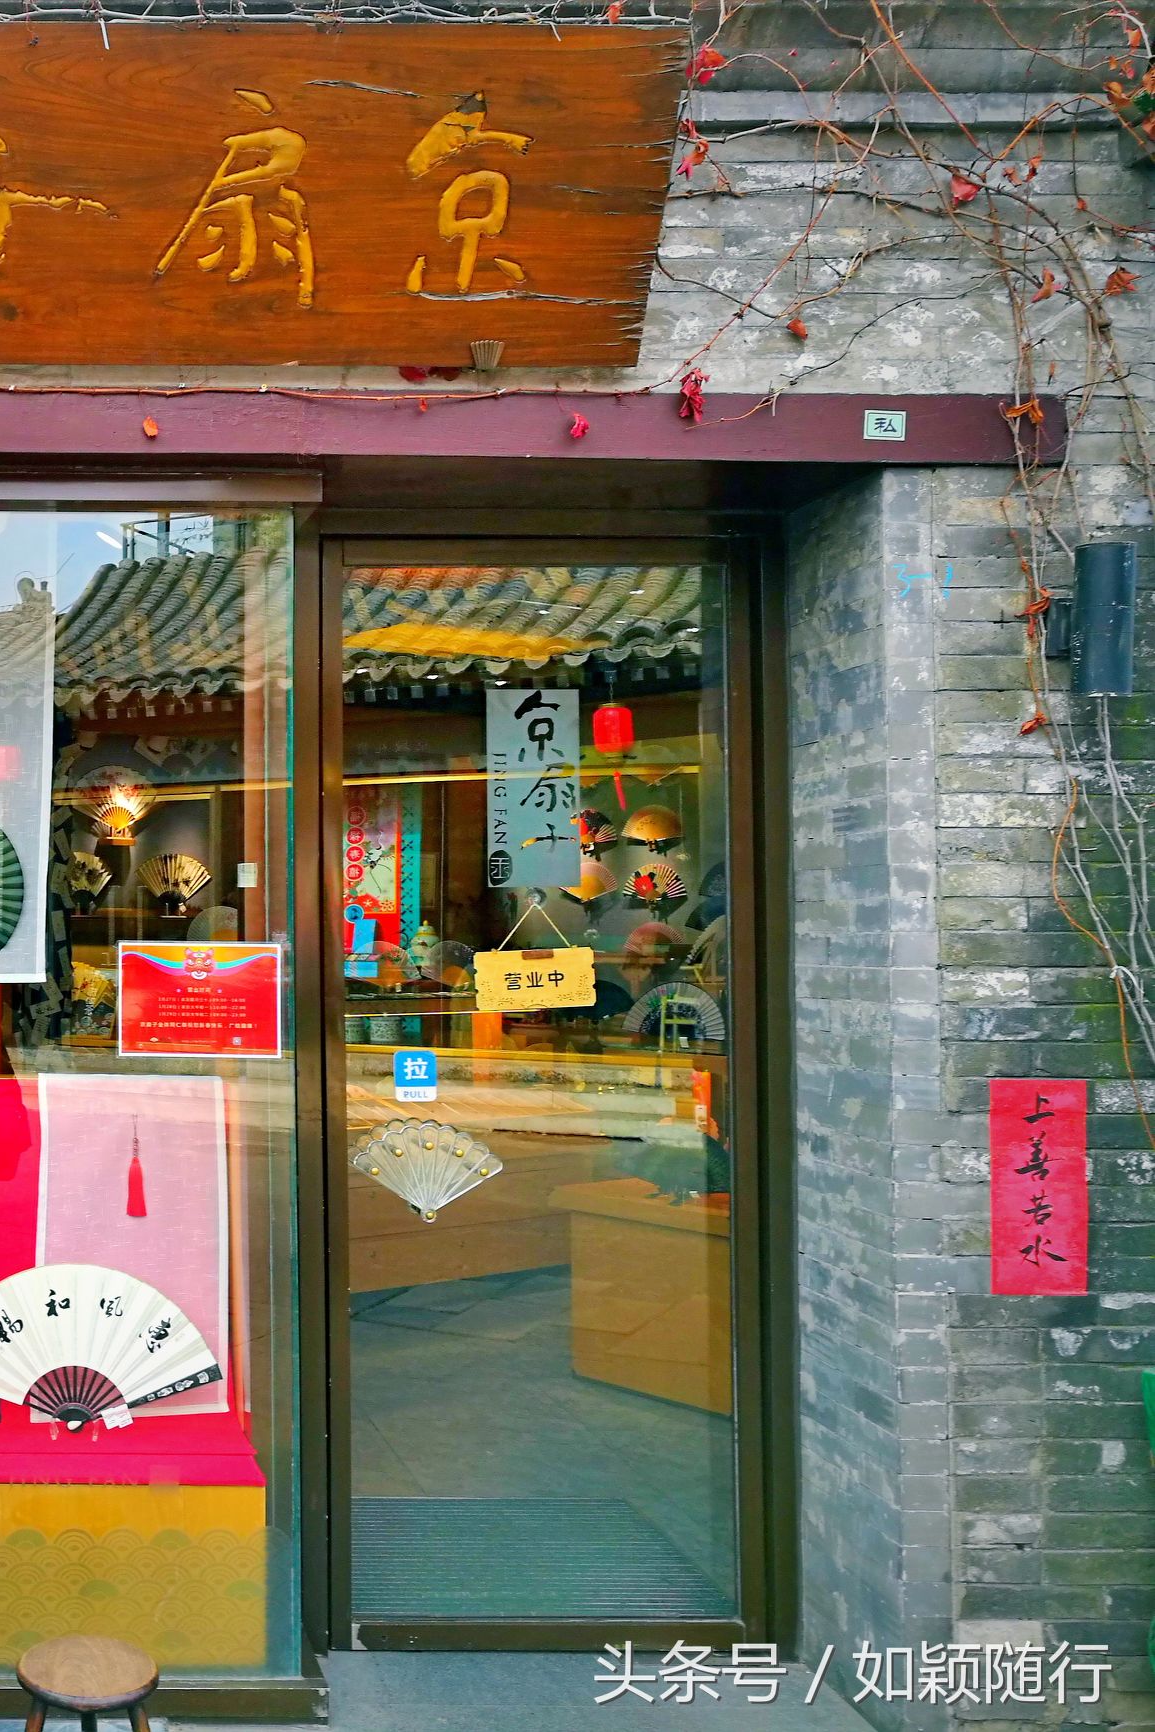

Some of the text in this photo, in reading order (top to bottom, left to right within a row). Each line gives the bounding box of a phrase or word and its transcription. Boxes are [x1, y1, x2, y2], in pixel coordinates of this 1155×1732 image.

[873, 417, 897, 433] 私
[494, 808, 508, 845] FAN
[504, 970, 565, 991] 营业中
[403, 1057, 429, 1080] 拉
[403, 1090, 428, 1099] PULL
[1015, 1091, 1069, 1268] 上善若水
